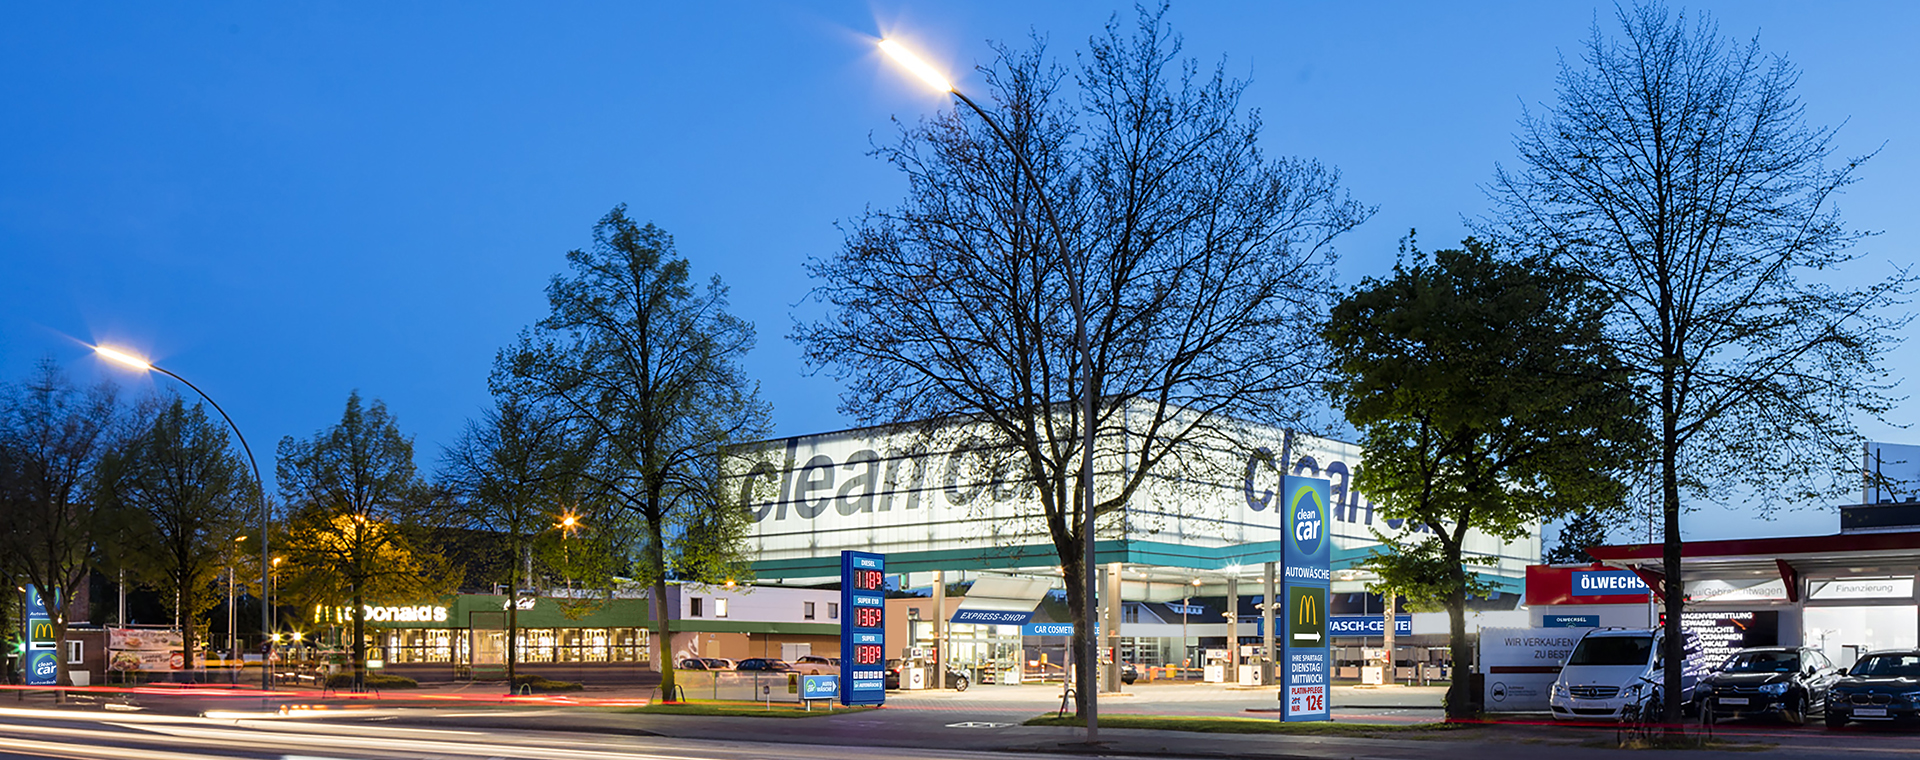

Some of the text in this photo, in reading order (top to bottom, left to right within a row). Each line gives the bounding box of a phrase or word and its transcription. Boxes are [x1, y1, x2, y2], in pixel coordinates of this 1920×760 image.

[1297, 508, 1316, 520] clean
[1295, 519, 1321, 541] car
[861, 559, 876, 567] DIESEL
[1285, 566, 1330, 580] AUTOWÄSCHE
[1836, 585, 1893, 593] Finanzierung
[857, 597, 871, 605] SUPER
[960, 611, 1026, 622] EXPRESS-SHOP
[1034, 625, 1047, 634] CAR
[861, 635, 876, 643] SUPER
[1504, 637, 1521, 647] WIR
[1523, 637, 1574, 647] VERKAUFEN
[1534, 650, 1546, 659] ZU
[37, 665, 57, 675] car
[1291, 674, 1323, 683] MITTWOCH
[1291, 686, 1323, 694] PLATIN-PFLEGE
[1306, 695, 1323, 711] 12€
